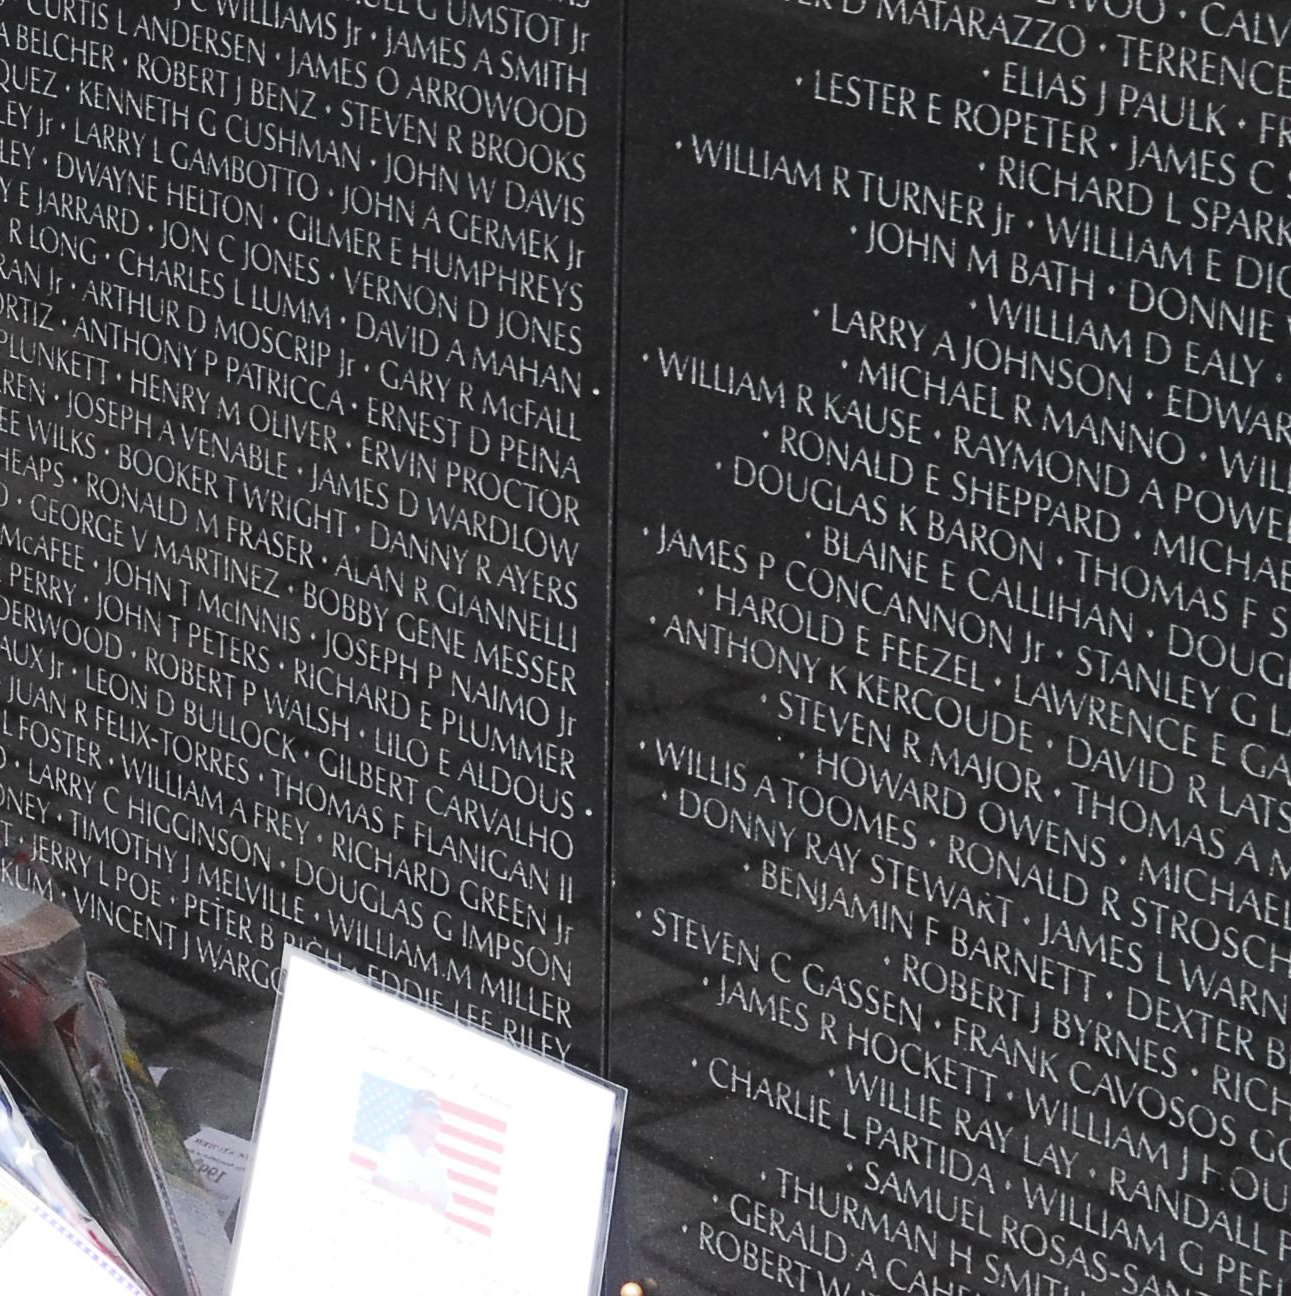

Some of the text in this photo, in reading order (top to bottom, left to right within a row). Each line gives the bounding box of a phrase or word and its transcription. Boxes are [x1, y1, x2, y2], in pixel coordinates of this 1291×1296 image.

[815, 70, 1098, 158] LESTER E ROPETER
[692, 134, 1015, 236] WILLIAM R TURNER Jr
[865, 221, 1094, 300] JOHN M BATH
[659, 348, 921, 444] WILLIAM R KAUSE
[304, 581, 576, 695] BOBBY GENE MESSER
[657, 524, 1045, 663] JAMES P CONCANNON Jr
[824, 526, 1132, 642] BLAINE E CALLIHAN
[323, 629, 577, 737] JOSEPH P NAIMO Jr
[656, 739, 916, 849] WILLIS A TOOMES
[652, 908, 1236, 1146] STEVEN C GASSEN FRANK CAVOSOS
[709, 1058, 995, 1194] CHARLIE L PARTIDA
